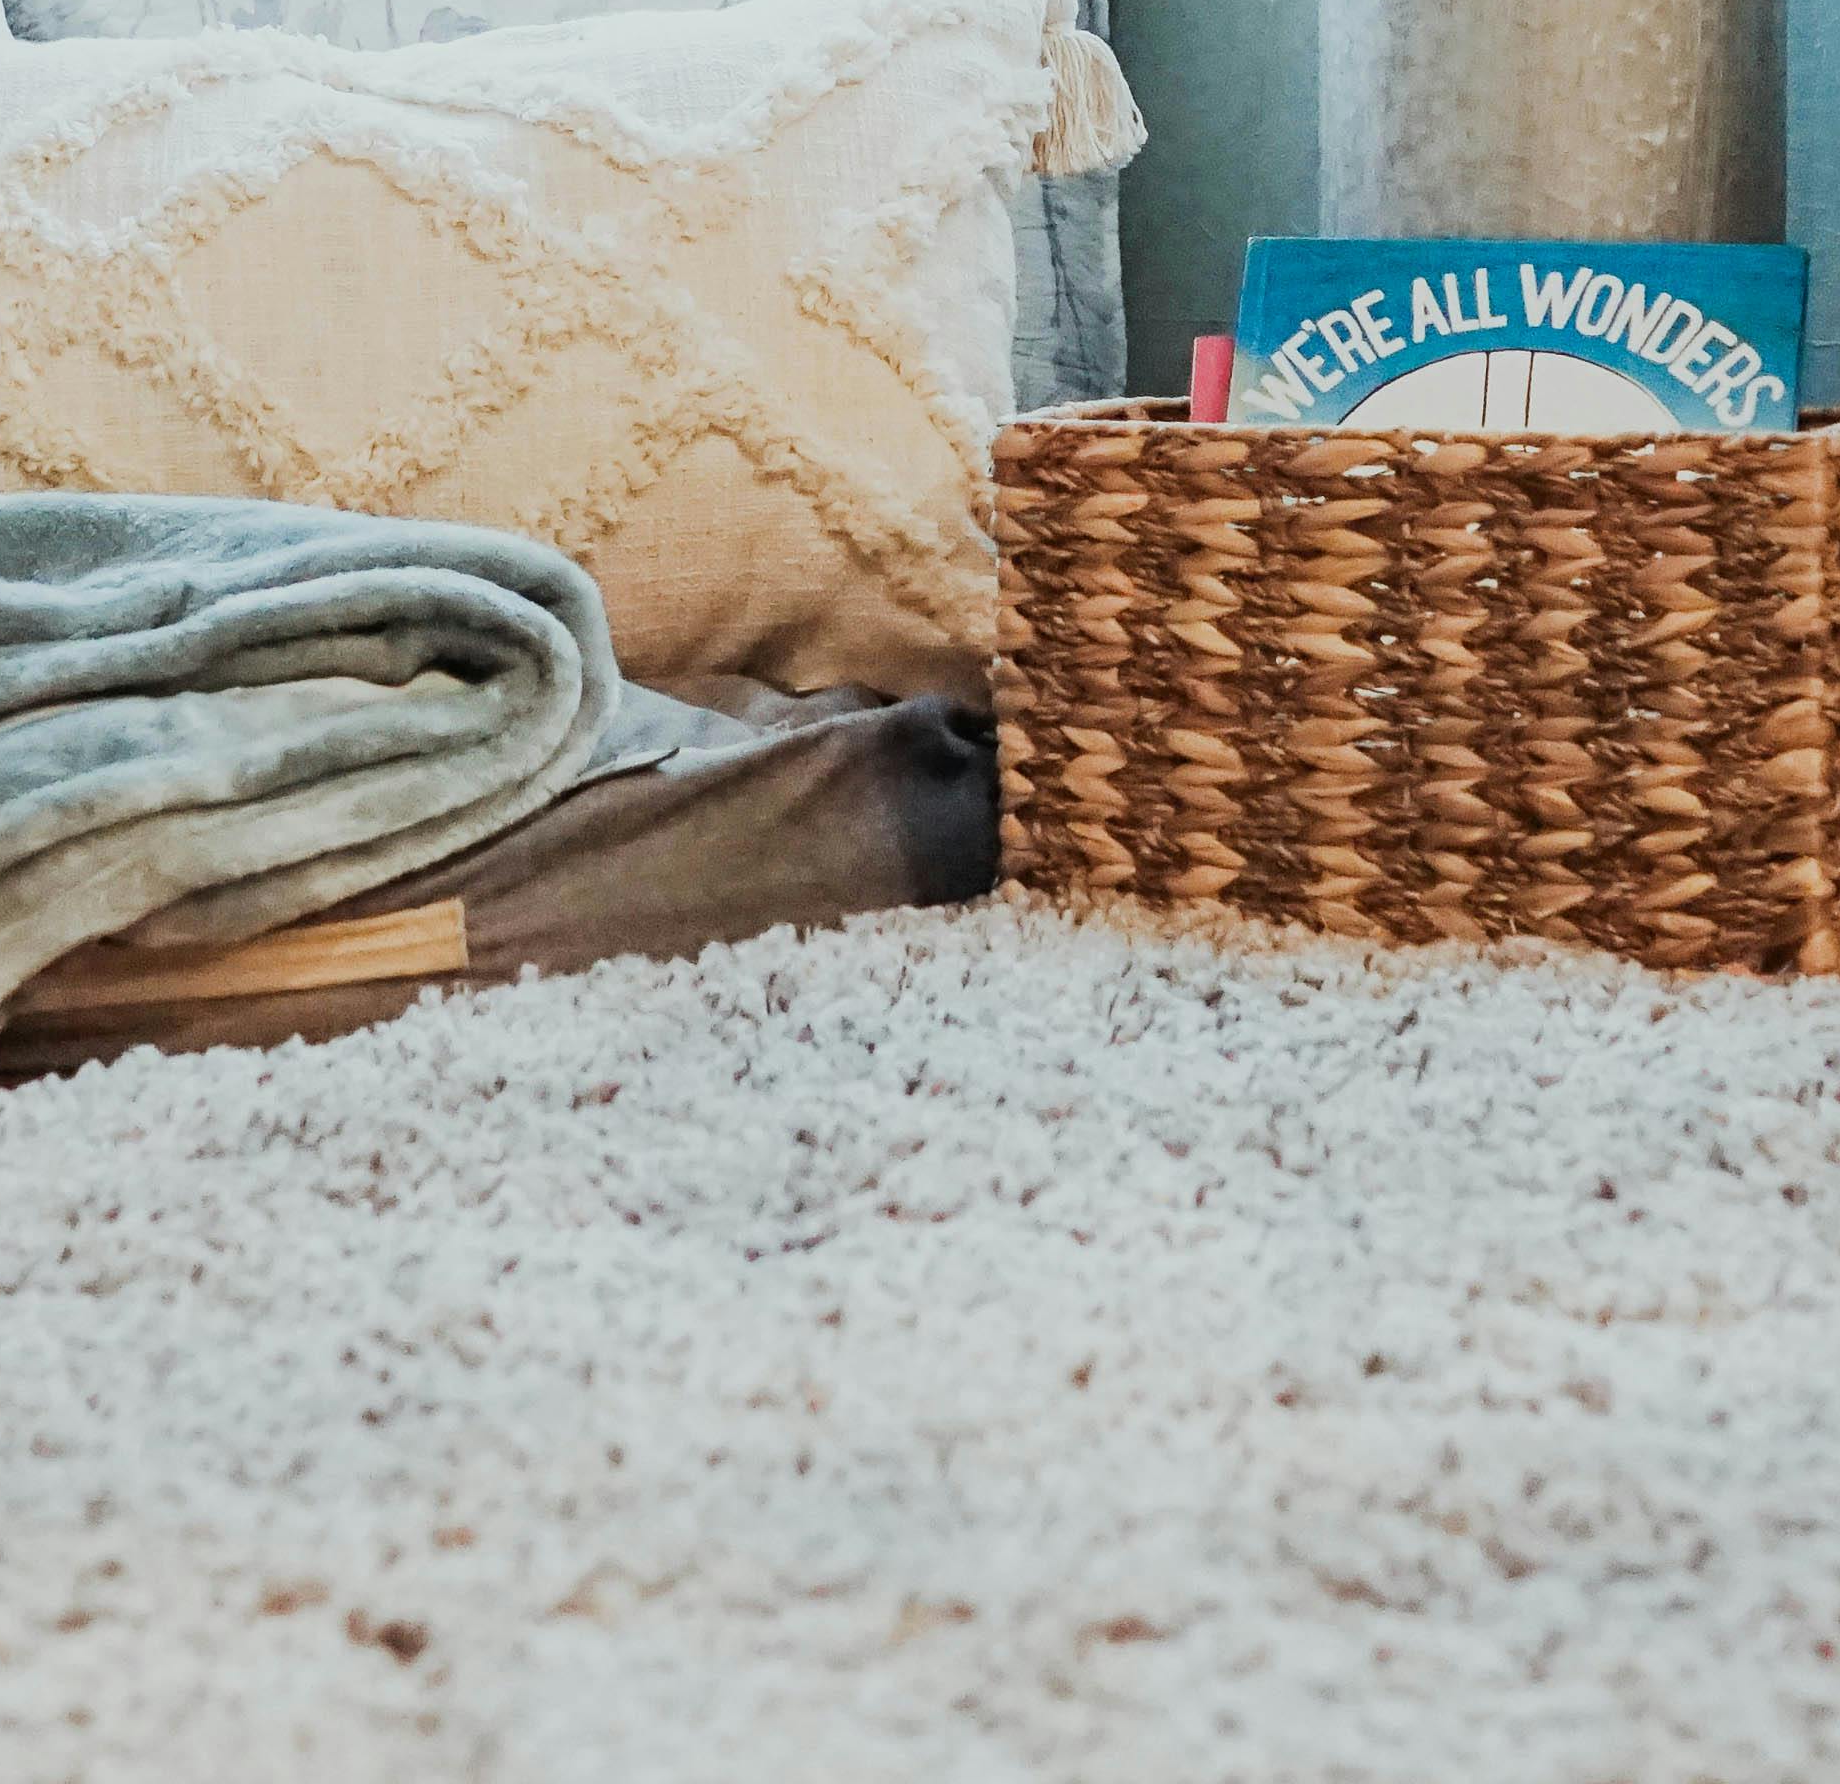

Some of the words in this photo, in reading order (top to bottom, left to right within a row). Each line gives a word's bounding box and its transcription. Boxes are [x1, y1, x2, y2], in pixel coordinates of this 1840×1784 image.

[1241, 289, 1408, 420] WE'RE
[1411, 267, 1509, 344] ALL
[1518, 262, 1785, 429] WONDERS
